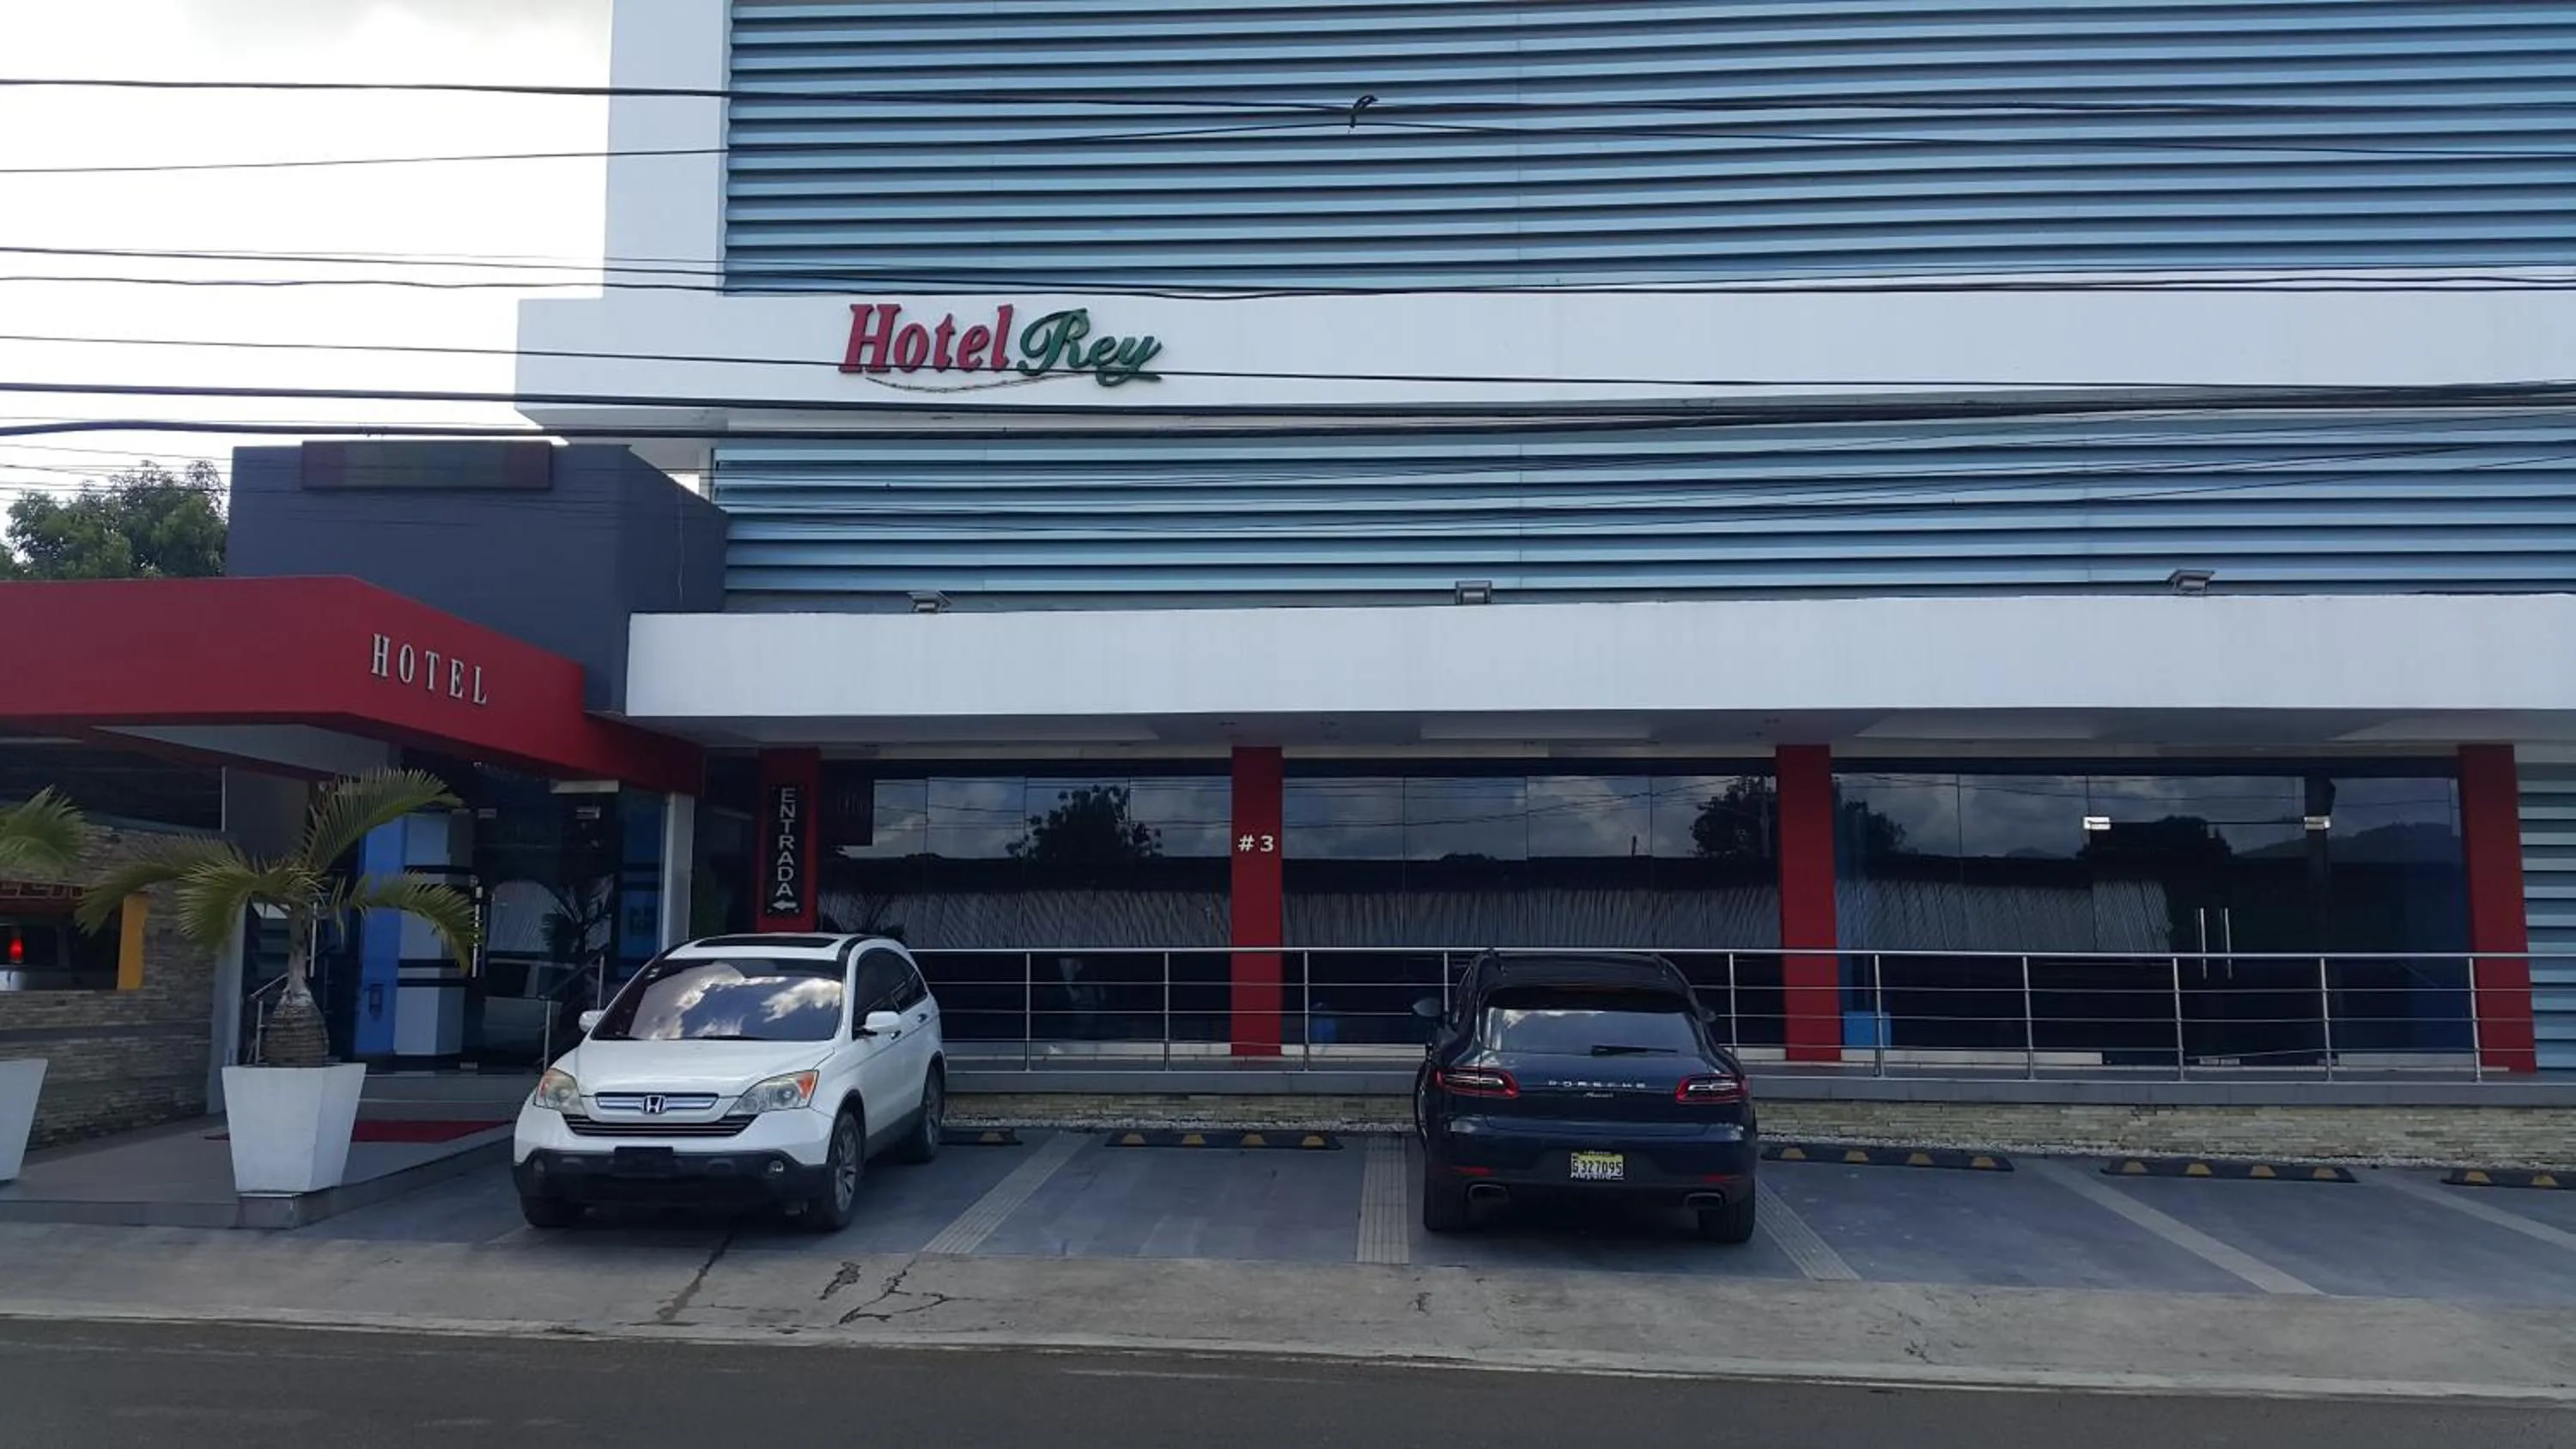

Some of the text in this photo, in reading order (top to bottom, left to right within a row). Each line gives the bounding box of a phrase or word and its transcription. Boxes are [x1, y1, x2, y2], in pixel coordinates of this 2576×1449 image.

[838, 303, 1163, 387] Hotel Rey
[371, 633, 487, 705] HOTEL
[775, 787, 797, 897] ENTRADA
